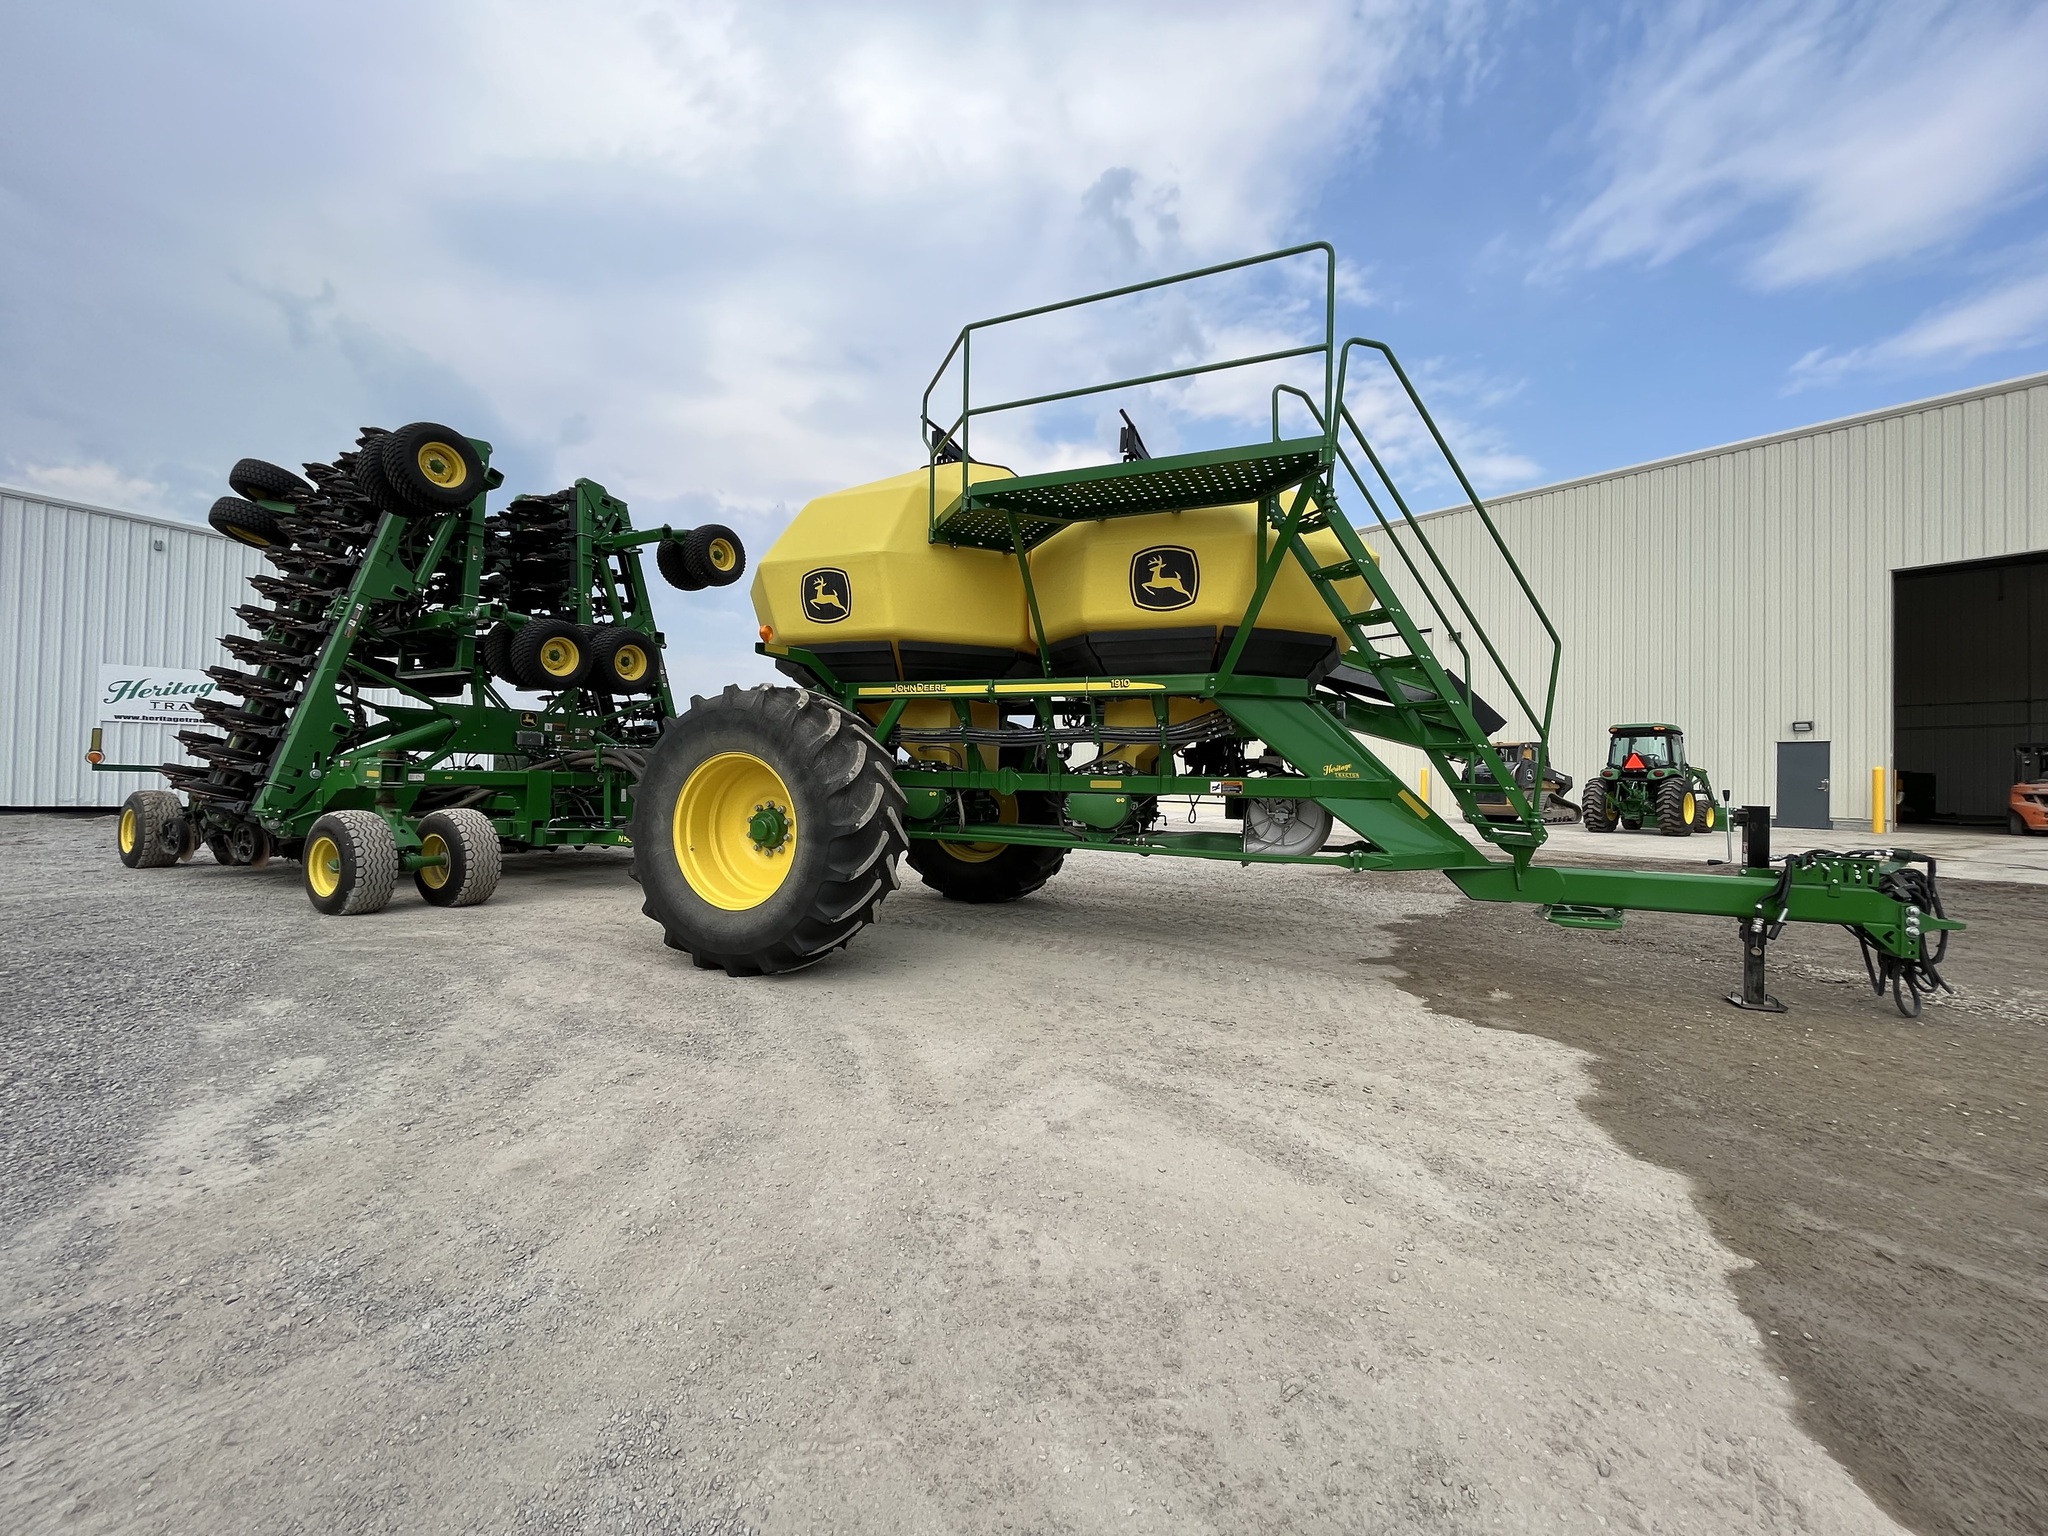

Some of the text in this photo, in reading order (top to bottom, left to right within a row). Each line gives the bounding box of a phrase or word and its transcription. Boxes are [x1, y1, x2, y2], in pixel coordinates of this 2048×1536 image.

[892, 682, 947, 693] JOHN DEERE
[1110, 679, 1131, 689] 1910
[1322, 763, 1352, 776] Heritage
